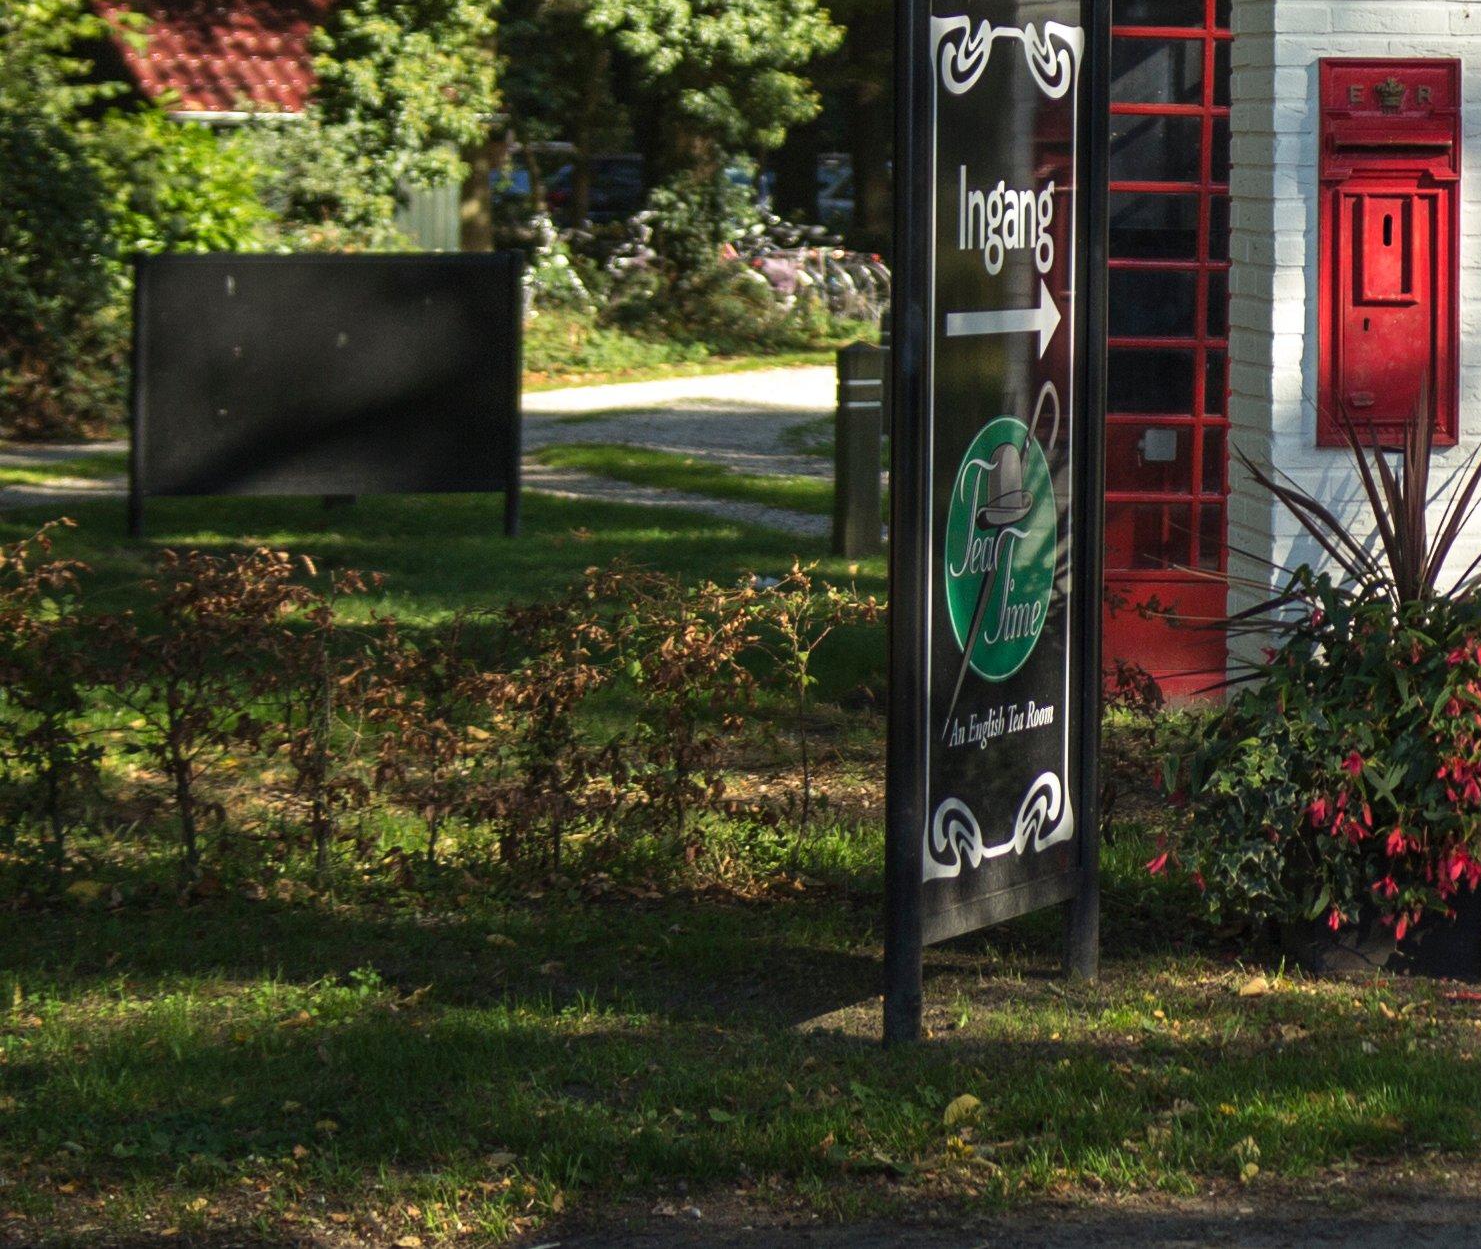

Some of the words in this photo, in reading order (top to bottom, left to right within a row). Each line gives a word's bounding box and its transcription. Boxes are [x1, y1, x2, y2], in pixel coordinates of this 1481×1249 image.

[1349, 85, 1364, 104] E
[1417, 84, 1431, 104] R
[960, 165, 1054, 275] Ingang
[949, 458, 999, 577] Tea
[984, 527, 1042, 645] Time
[949, 718, 965, 747] An
[968, 706, 1005, 750] English
[1008, 704, 1024, 733] Tea
[1025, 701, 1054, 729] Room
